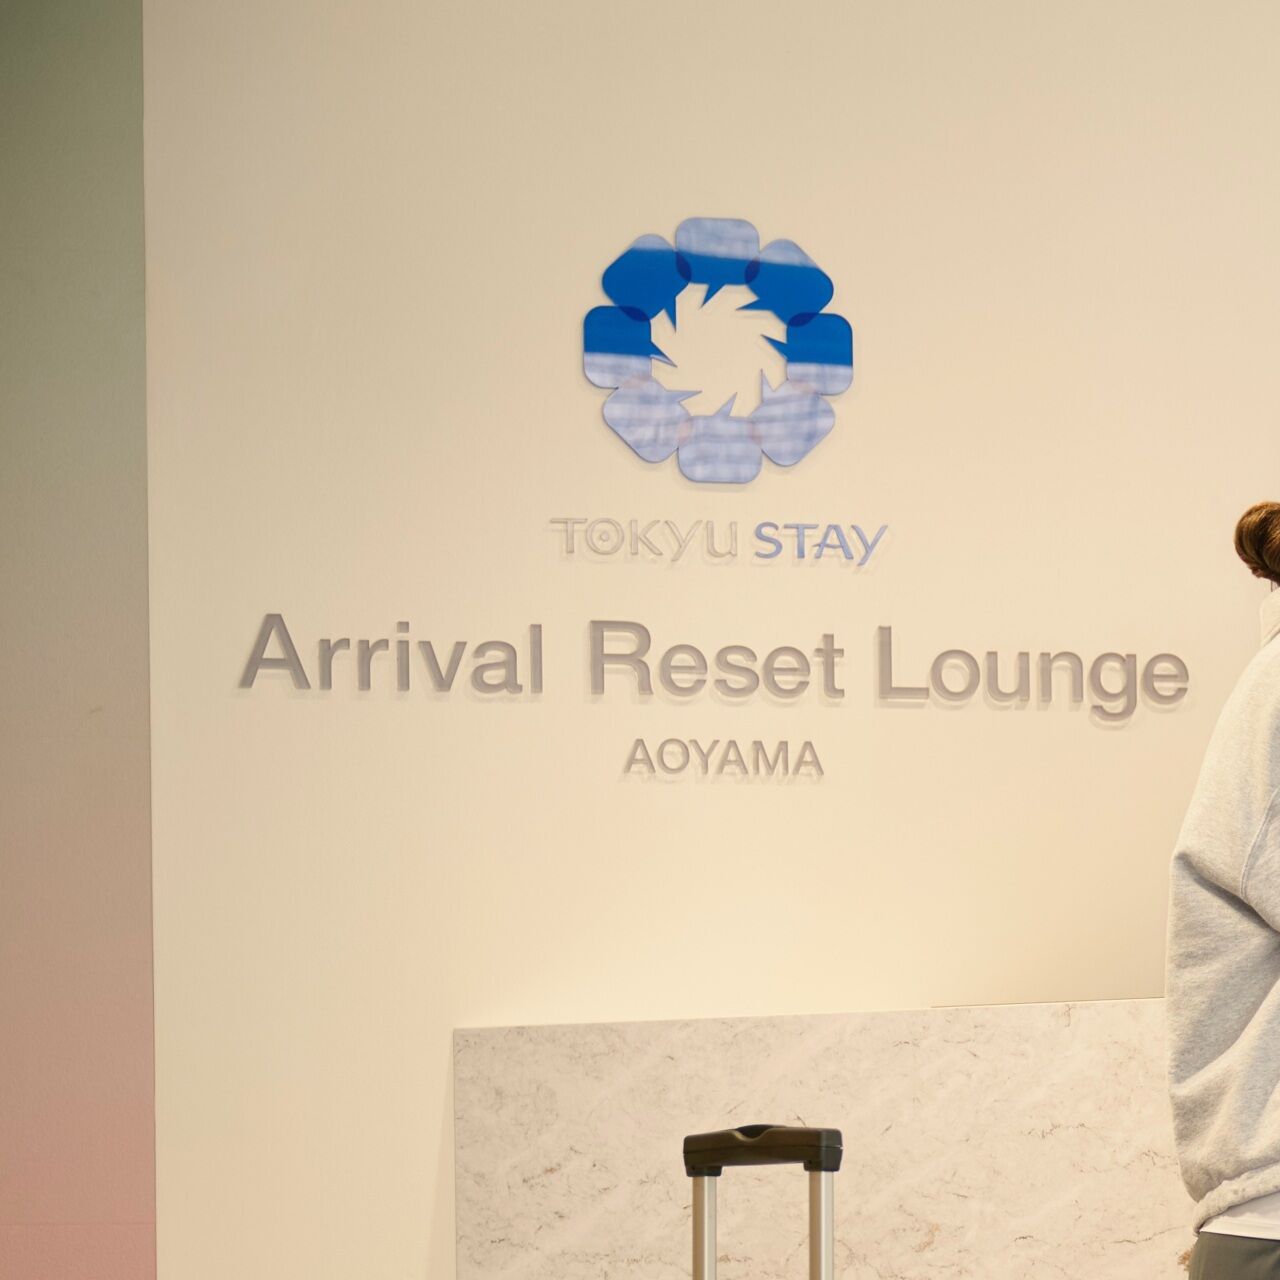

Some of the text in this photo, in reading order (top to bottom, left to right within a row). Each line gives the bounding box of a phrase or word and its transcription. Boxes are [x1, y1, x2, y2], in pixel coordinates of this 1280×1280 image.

[549, 517, 889, 567] TOKYU STAY
[238, 612, 1190, 722] Arrival Reset Lounge
[622, 737, 825, 777] AOYAMA
